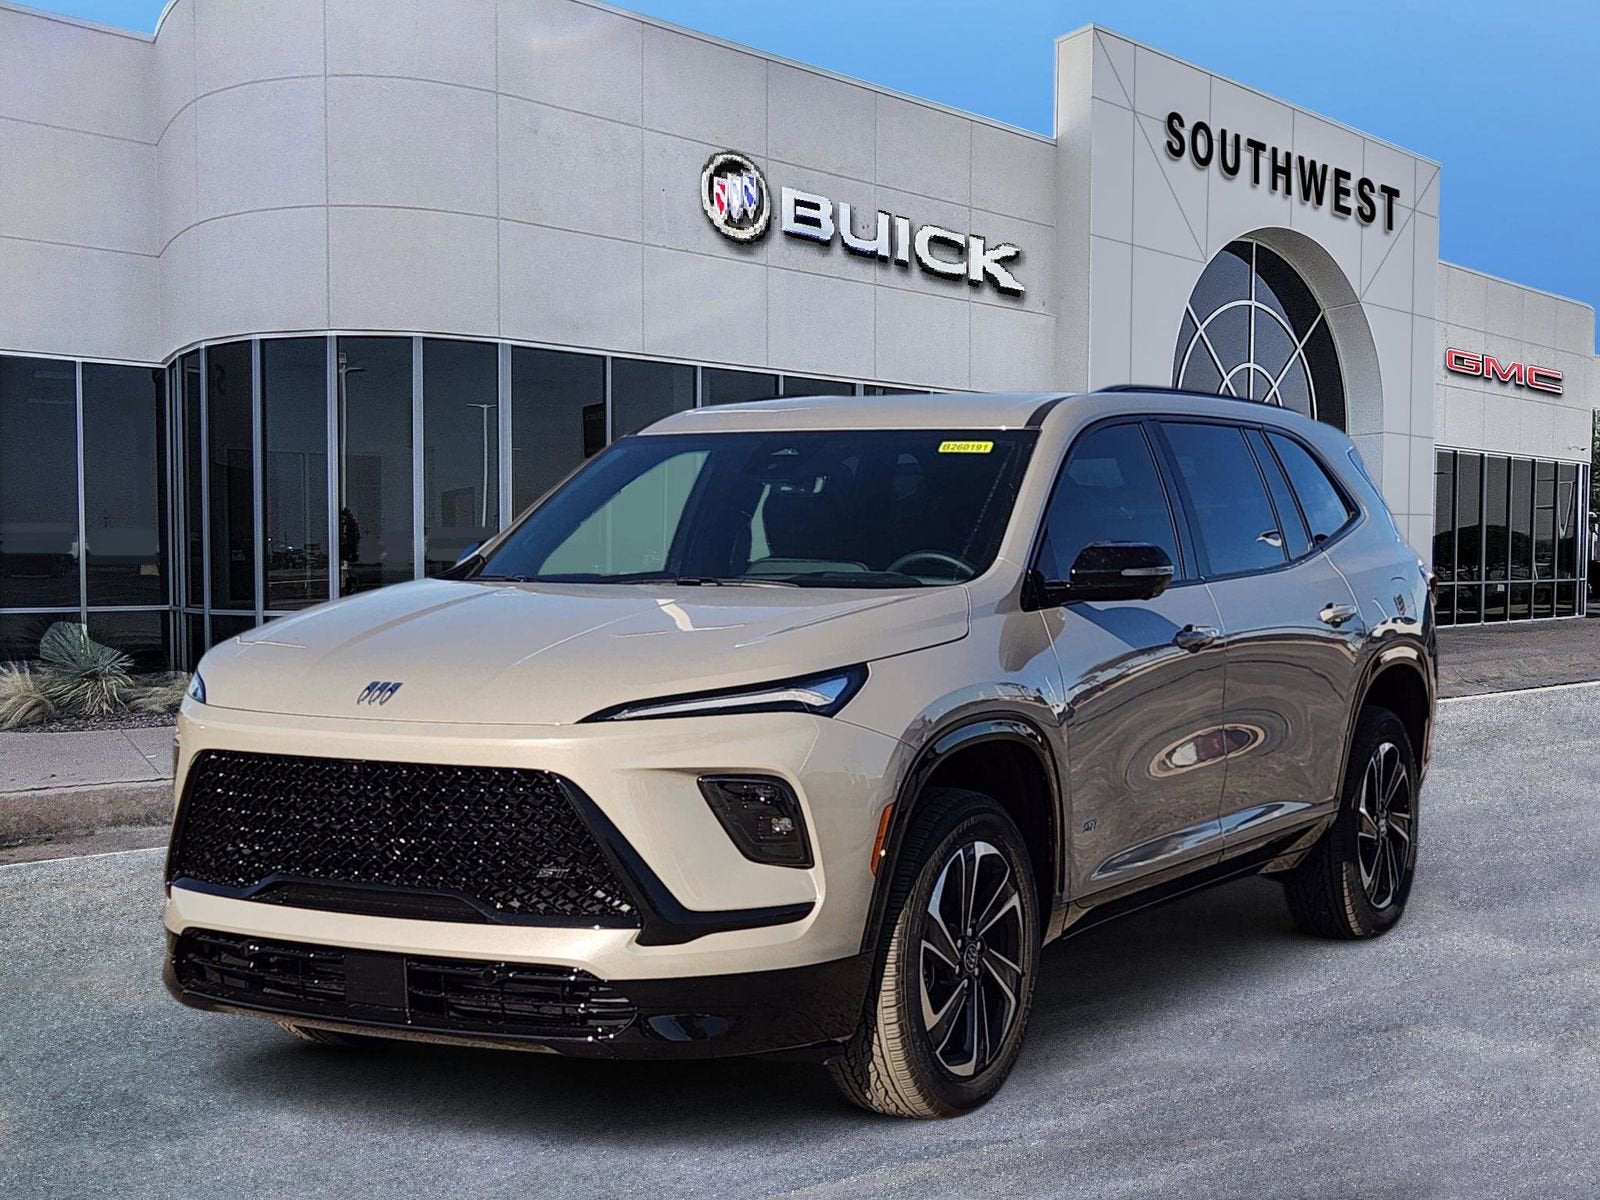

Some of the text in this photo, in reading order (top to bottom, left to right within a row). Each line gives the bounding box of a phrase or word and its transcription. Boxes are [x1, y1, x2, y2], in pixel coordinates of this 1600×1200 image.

[1166, 111, 1400, 231] SOUTHWEST
[782, 186, 1025, 296] BUICK
[1446, 348, 1563, 394] GMC
[941, 443, 990, 452] B260191
